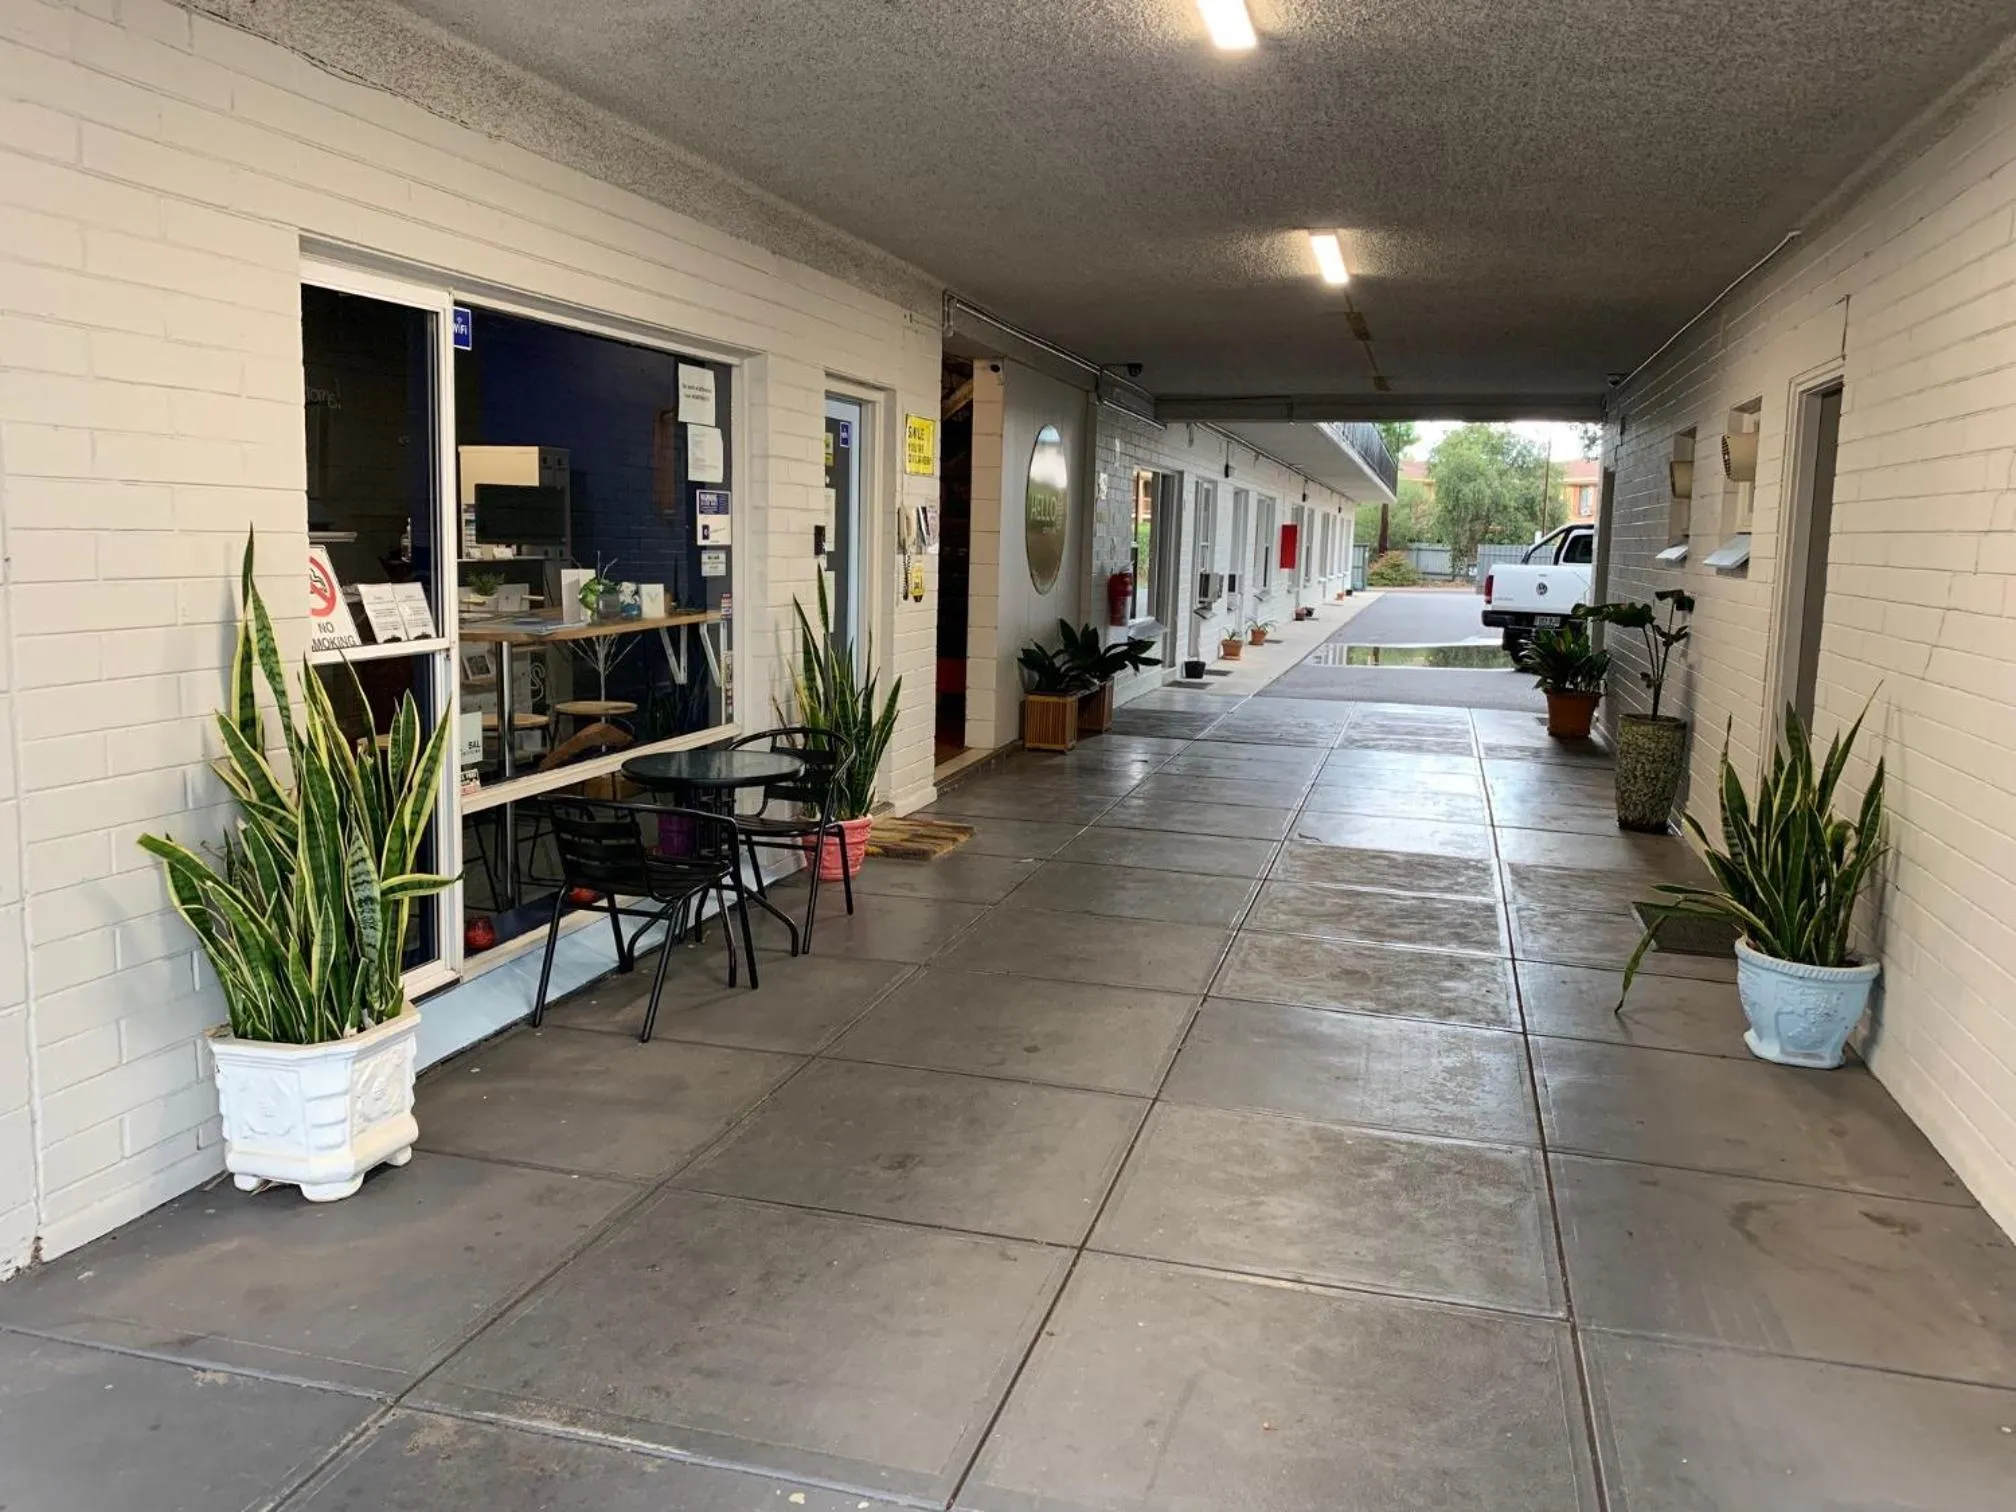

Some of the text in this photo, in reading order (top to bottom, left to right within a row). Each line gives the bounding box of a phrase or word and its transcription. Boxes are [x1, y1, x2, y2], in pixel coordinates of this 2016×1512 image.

[1031, 495, 1057, 521] HELLO
[318, 621, 335, 634] NO
[312, 634, 357, 652] MOKING
